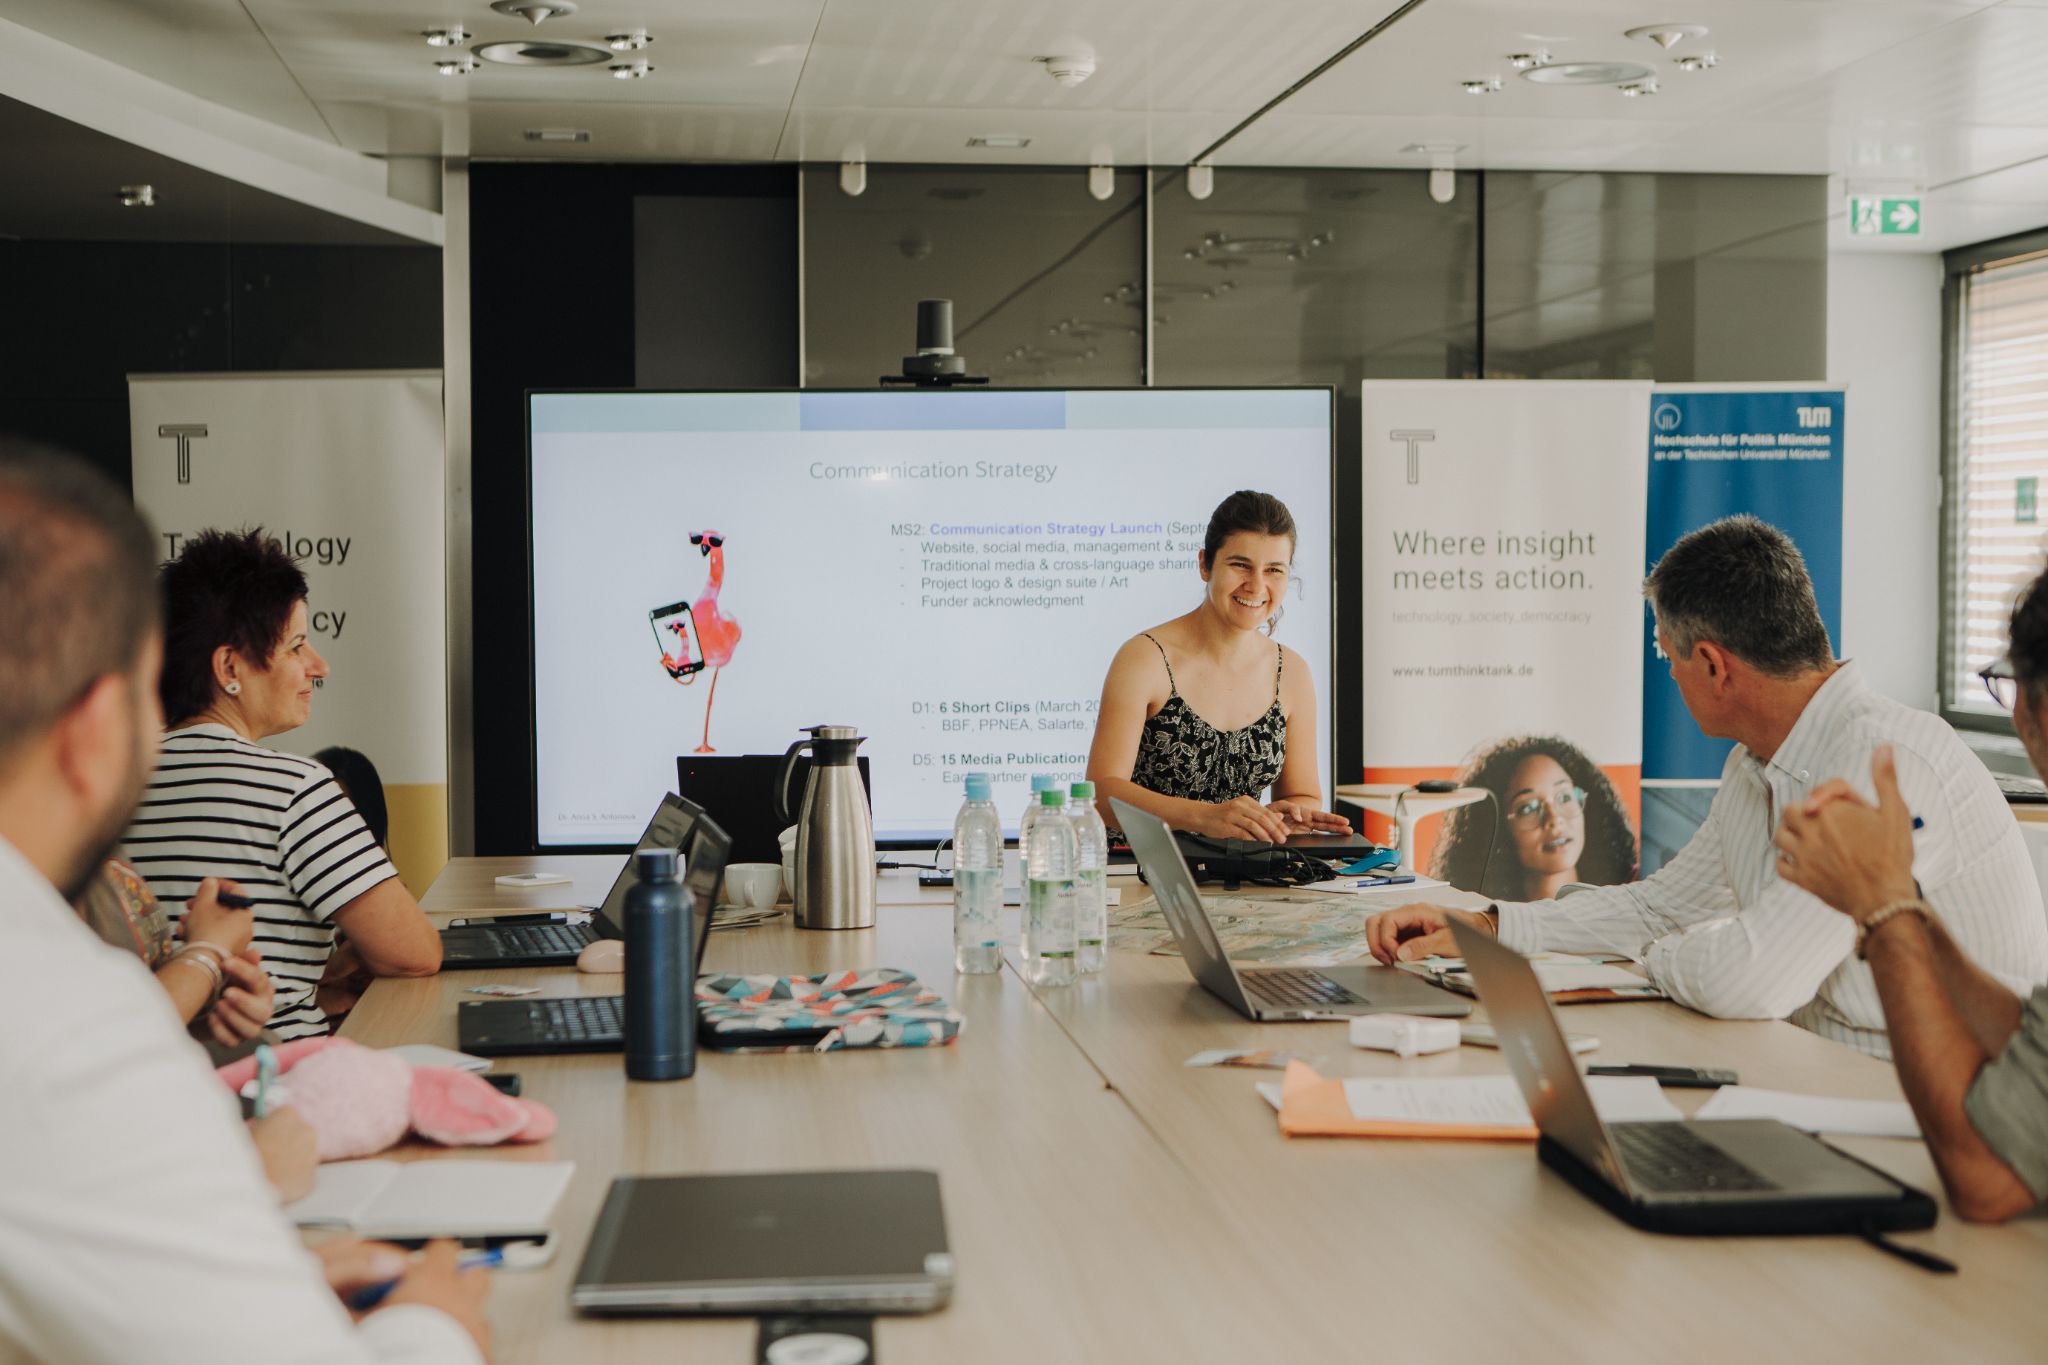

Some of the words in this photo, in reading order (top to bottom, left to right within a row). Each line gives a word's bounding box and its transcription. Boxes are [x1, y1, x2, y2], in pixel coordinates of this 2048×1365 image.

[1654, 433, 1720, 447] Hochschule
[1721, 433, 1738, 447] für
[1740, 433, 1776, 447] Politik
[1778, 432, 1831, 446] München
[1684, 449, 1739, 460] Technischen
[1789, 448, 1831, 459] München
[809, 460, 970, 480] Communication
[975, 460, 1058, 483] Strategy
[890, 522, 926, 537] MS2:
[929, 522, 1043, 536] Communication
[1046, 521, 1106, 538] Strategy
[1110, 521, 1163, 535] Launch
[1167, 520, 1209, 536] (Septe
[920, 540, 979, 555] Website,
[983, 540, 1021, 553] social
[1024, 540, 1069, 554] media,
[1073, 541, 1162, 557] management
[1164, 539, 1174, 552] &
[1392, 529, 1486, 556] Where
[1497, 529, 1596, 561] insight
[920, 558, 991, 572] Traditional
[995, 558, 1036, 571] media
[1039, 558, 1049, 571] &
[1052, 557, 1155, 574] cross-language
[1158, 557, 1200, 570] sharin
[920, 576, 968, 591] Project
[971, 576, 1000, 591] logo
[1003, 577, 1014, 589] &
[1017, 575, 1062, 591] design
[1065, 575, 1097, 588] suite
[1108, 575, 1129, 588] Art
[1392, 566, 1484, 590] meets
[1495, 565, 1594, 590] action.
[920, 594, 969, 608] Funder
[972, 593, 1085, 610] acknowledgment
[1392, 664, 1534, 678] www.tumthinktank.de
[911, 701, 935, 714] D1:
[939, 701, 948, 713] 6
[951, 701, 990, 713] Short
[994, 700, 1031, 716] Clips
[1034, 699, 1081, 715] (March
[1084, 699, 1100, 712] 20
[941, 719, 975, 733] BBF,
[912, 753, 935, 766] D5:
[940, 753, 956, 765] 15
[960, 752, 1002, 765] Media
[1006, 752, 1088, 765] Publication
[942, 770, 966, 784] Eac
